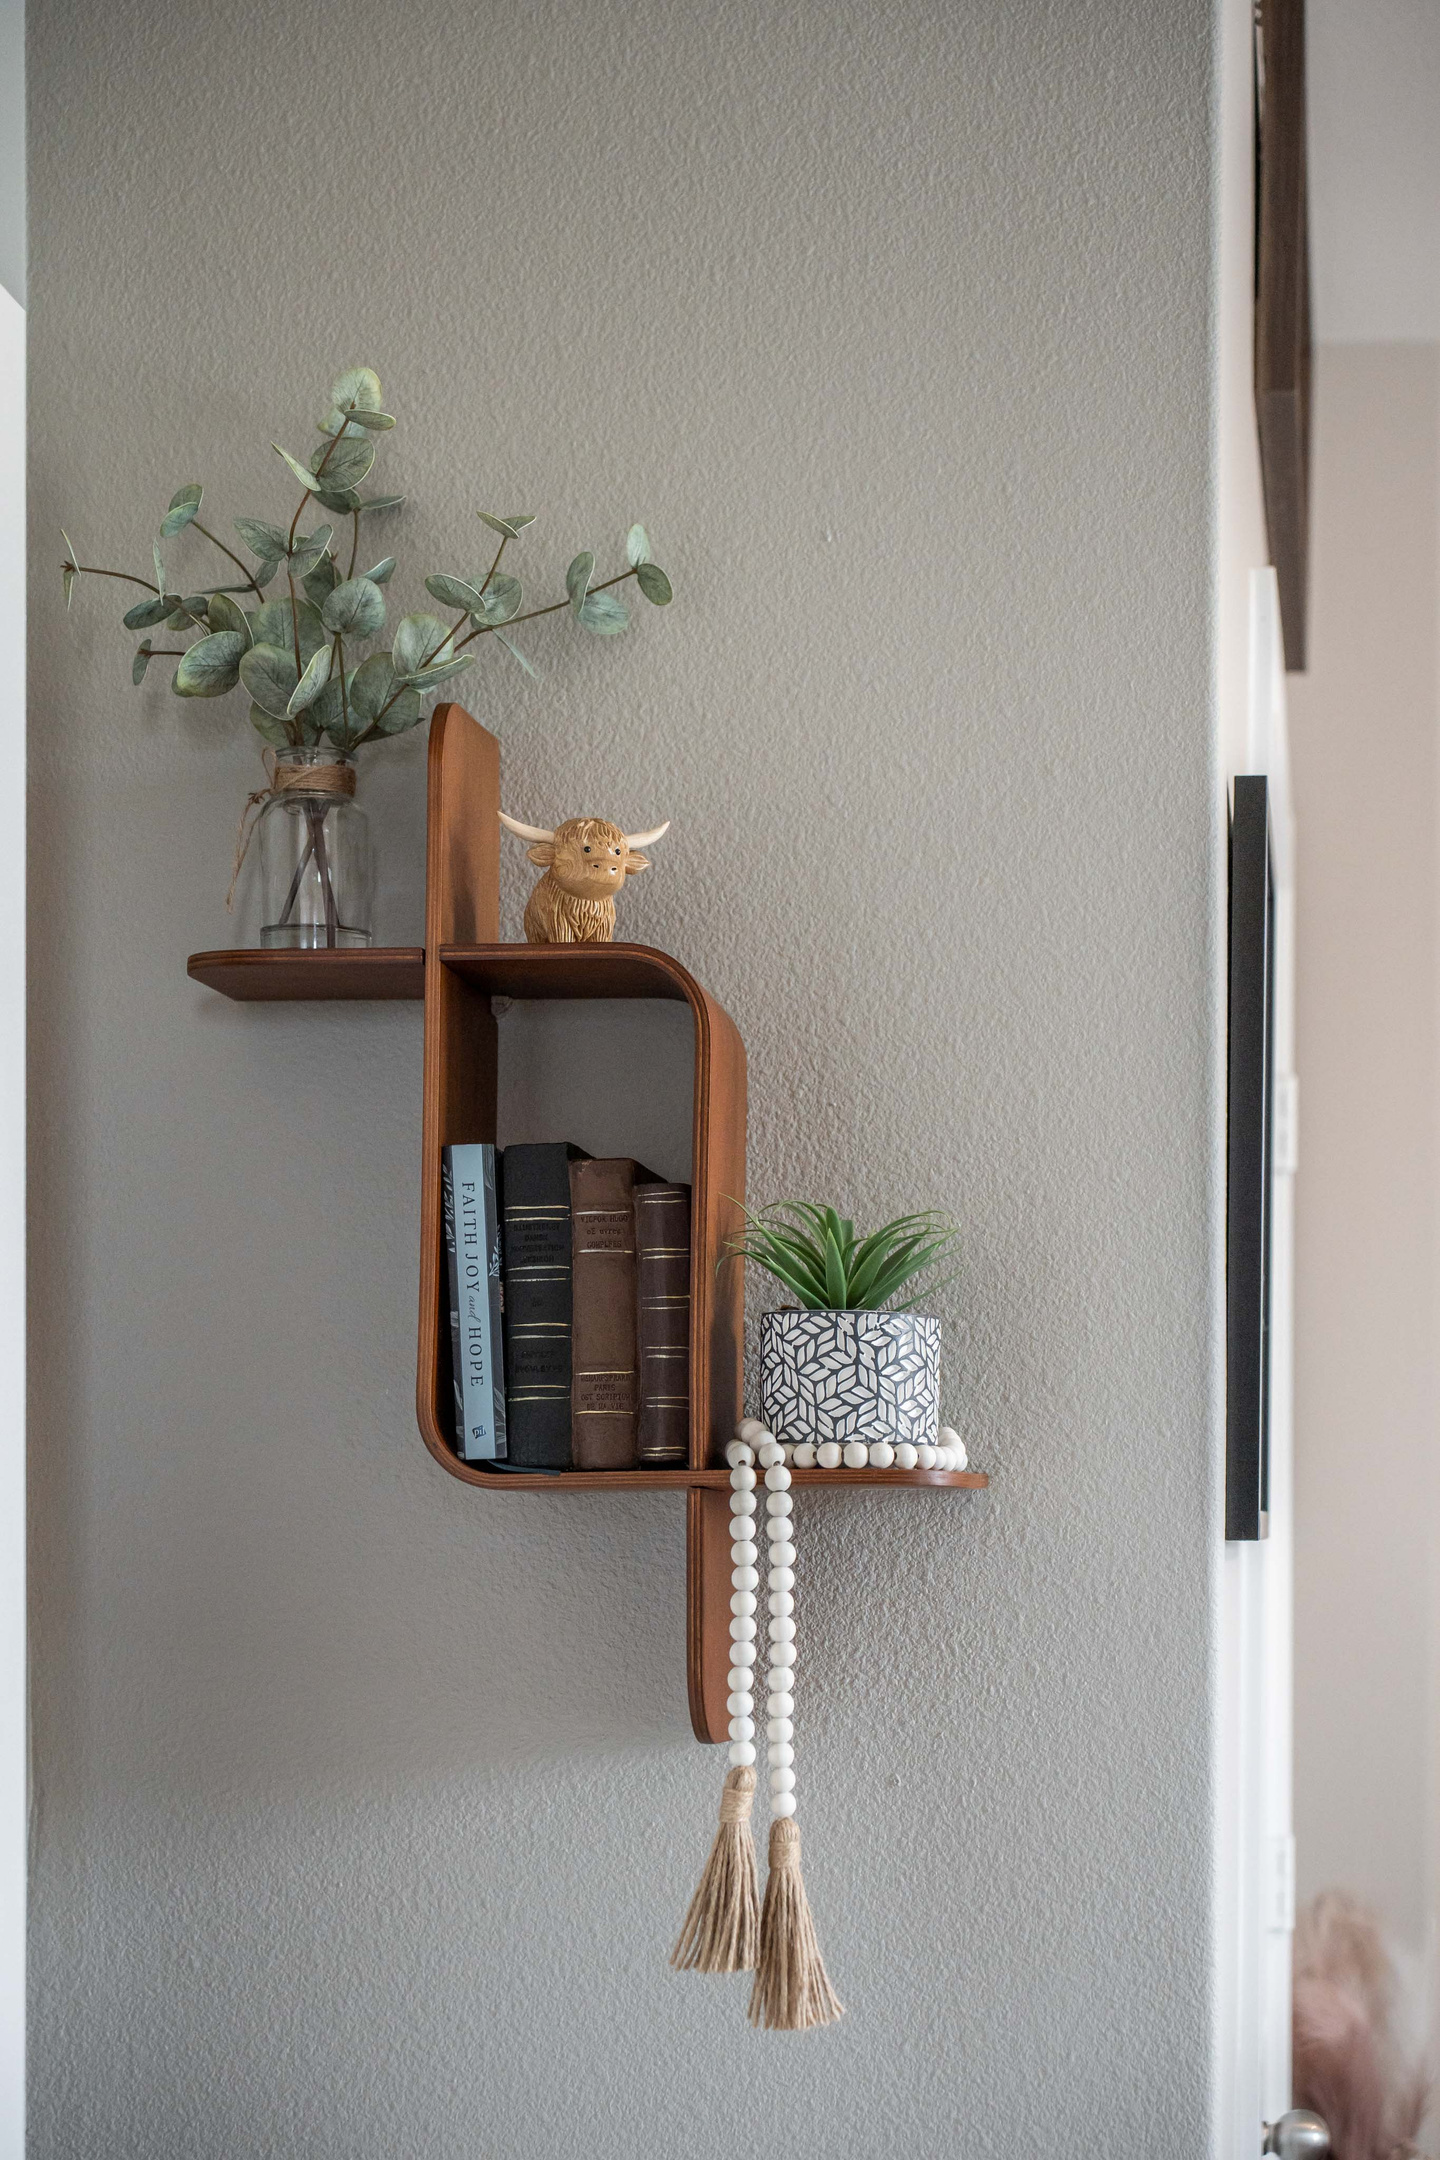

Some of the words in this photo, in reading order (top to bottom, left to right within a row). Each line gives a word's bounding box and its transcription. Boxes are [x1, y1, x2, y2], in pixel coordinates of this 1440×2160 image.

[462, 1182, 477, 1245] FAITH
[465, 1253, 480, 1292] JOY
[468, 1295, 481, 1323] and
[468, 1327, 484, 1387] HOPE
